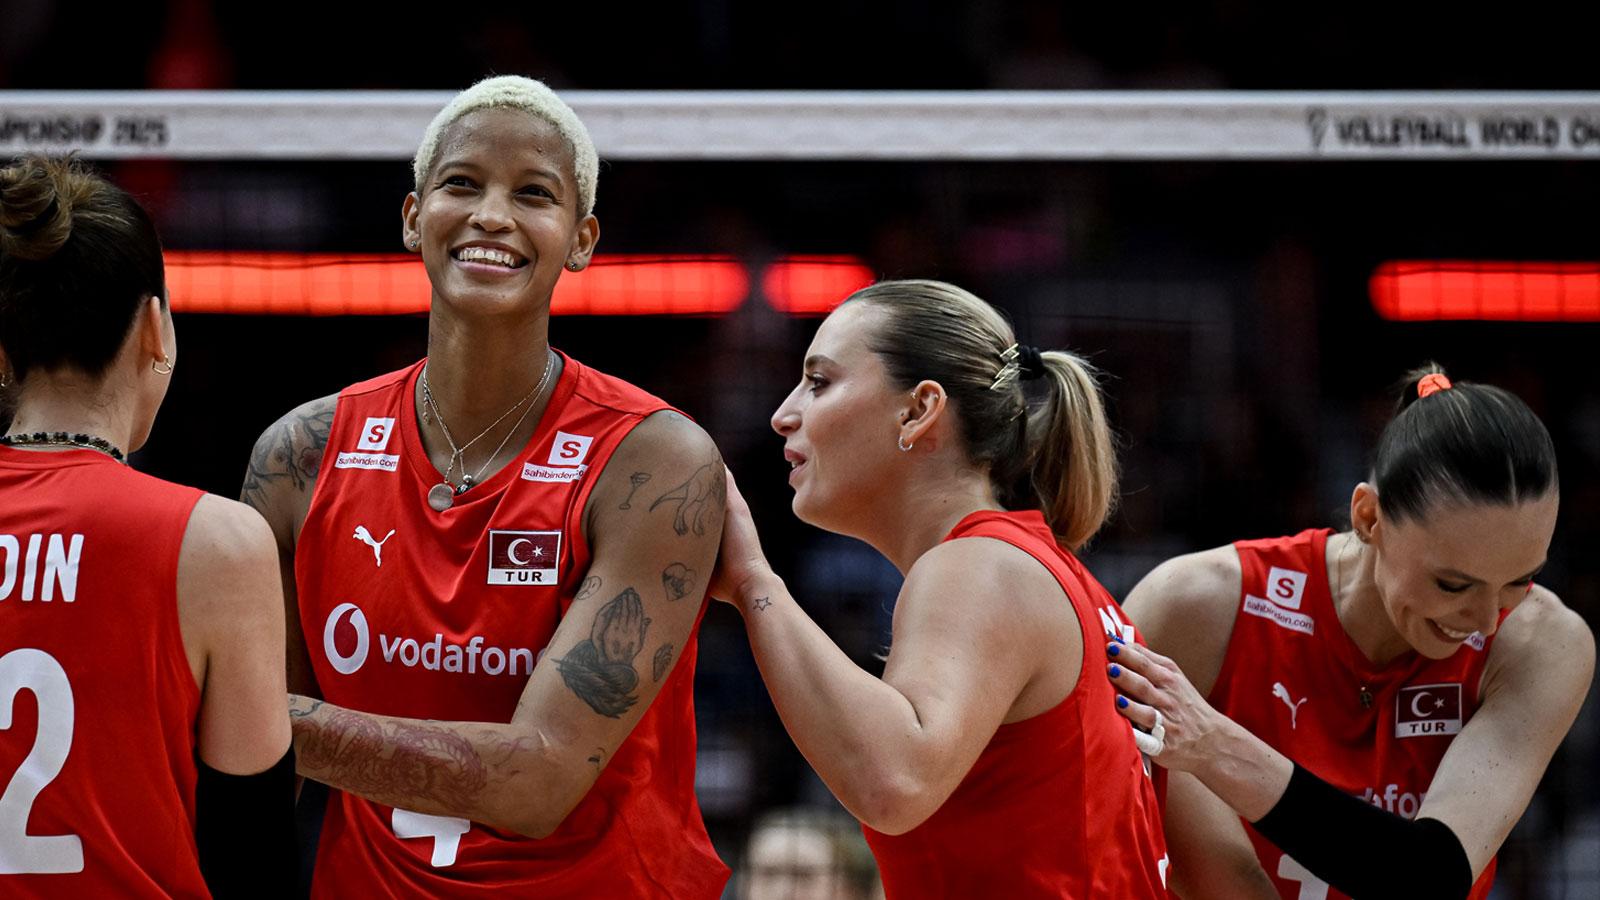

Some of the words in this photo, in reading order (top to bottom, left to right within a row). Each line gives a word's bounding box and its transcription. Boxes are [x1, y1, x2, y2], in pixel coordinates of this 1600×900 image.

[1337, 116, 1468, 146] VOLLEYBALL
[1478, 117, 1559, 147] WORLD
[368, 424, 385, 444] S
[560, 440, 582, 459] S
[505, 570, 543, 582] TUR
[1275, 577, 1295, 599] S
[379, 633, 546, 676] vodafon
[1410, 721, 1446, 733] TUR
